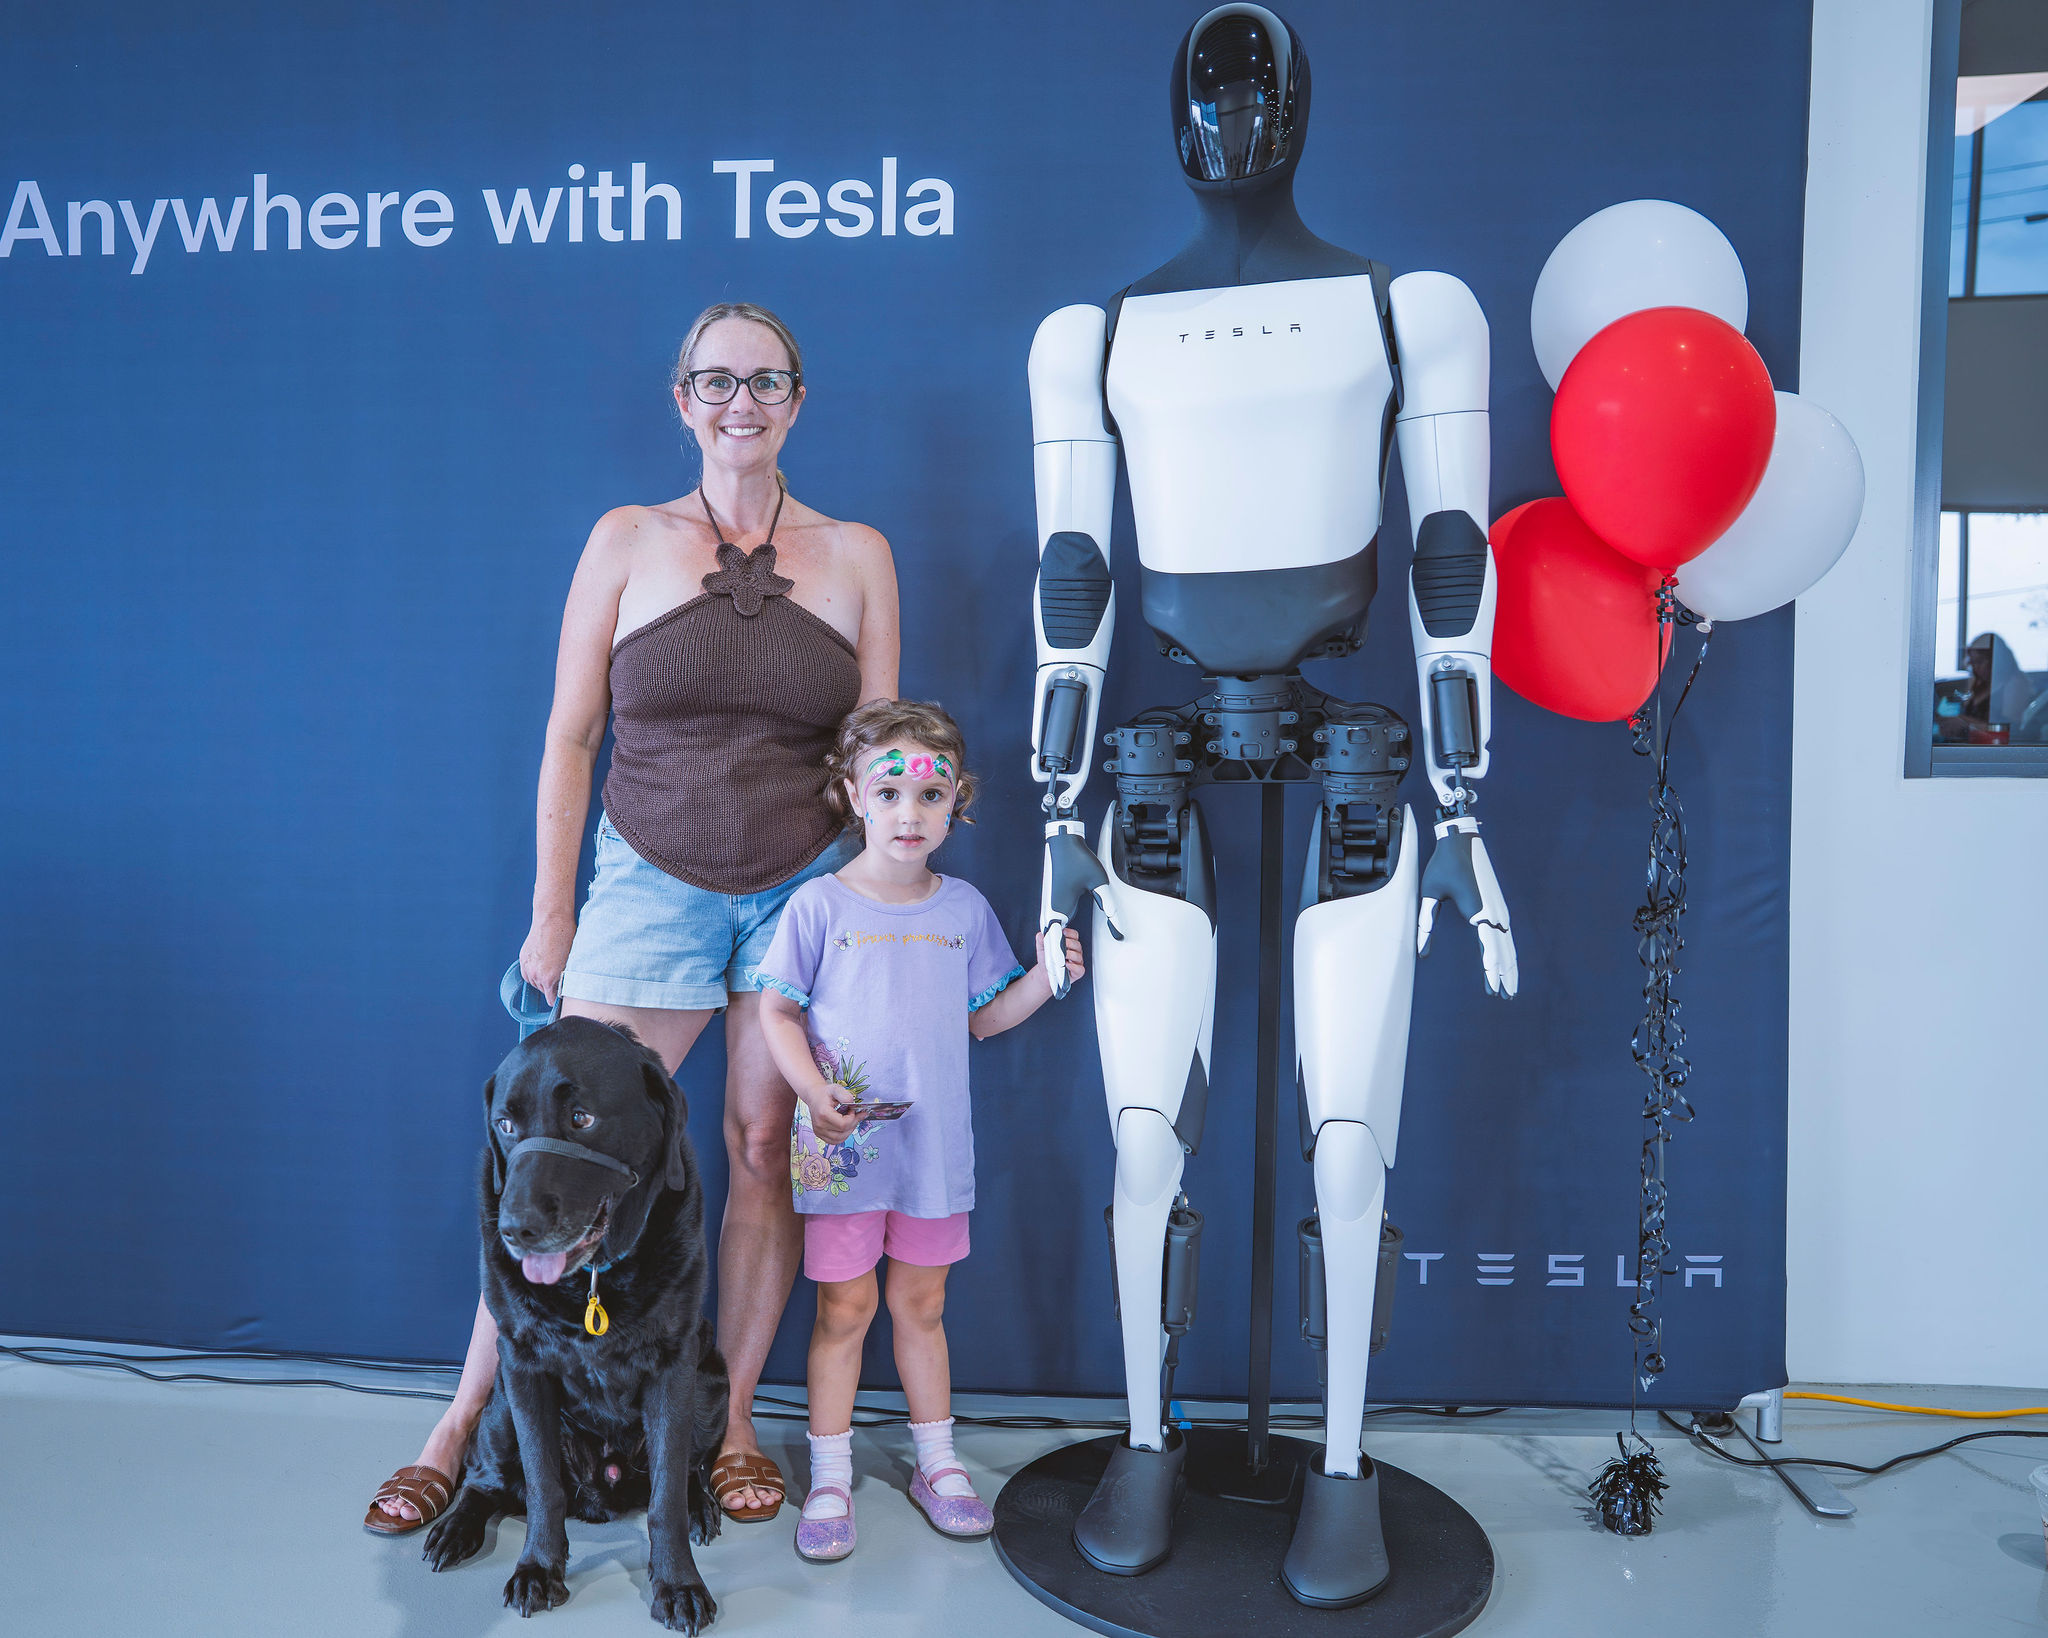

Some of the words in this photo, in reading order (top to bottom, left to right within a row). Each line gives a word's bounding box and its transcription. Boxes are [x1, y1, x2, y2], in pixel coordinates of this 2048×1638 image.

[0, 172, 455, 275] Anywhere
[481, 162, 683, 245] with
[712, 156, 956, 239] Tesla
[1178, 323, 1302, 343] TESLA
[1402, 1252, 1724, 1288] TESLA
